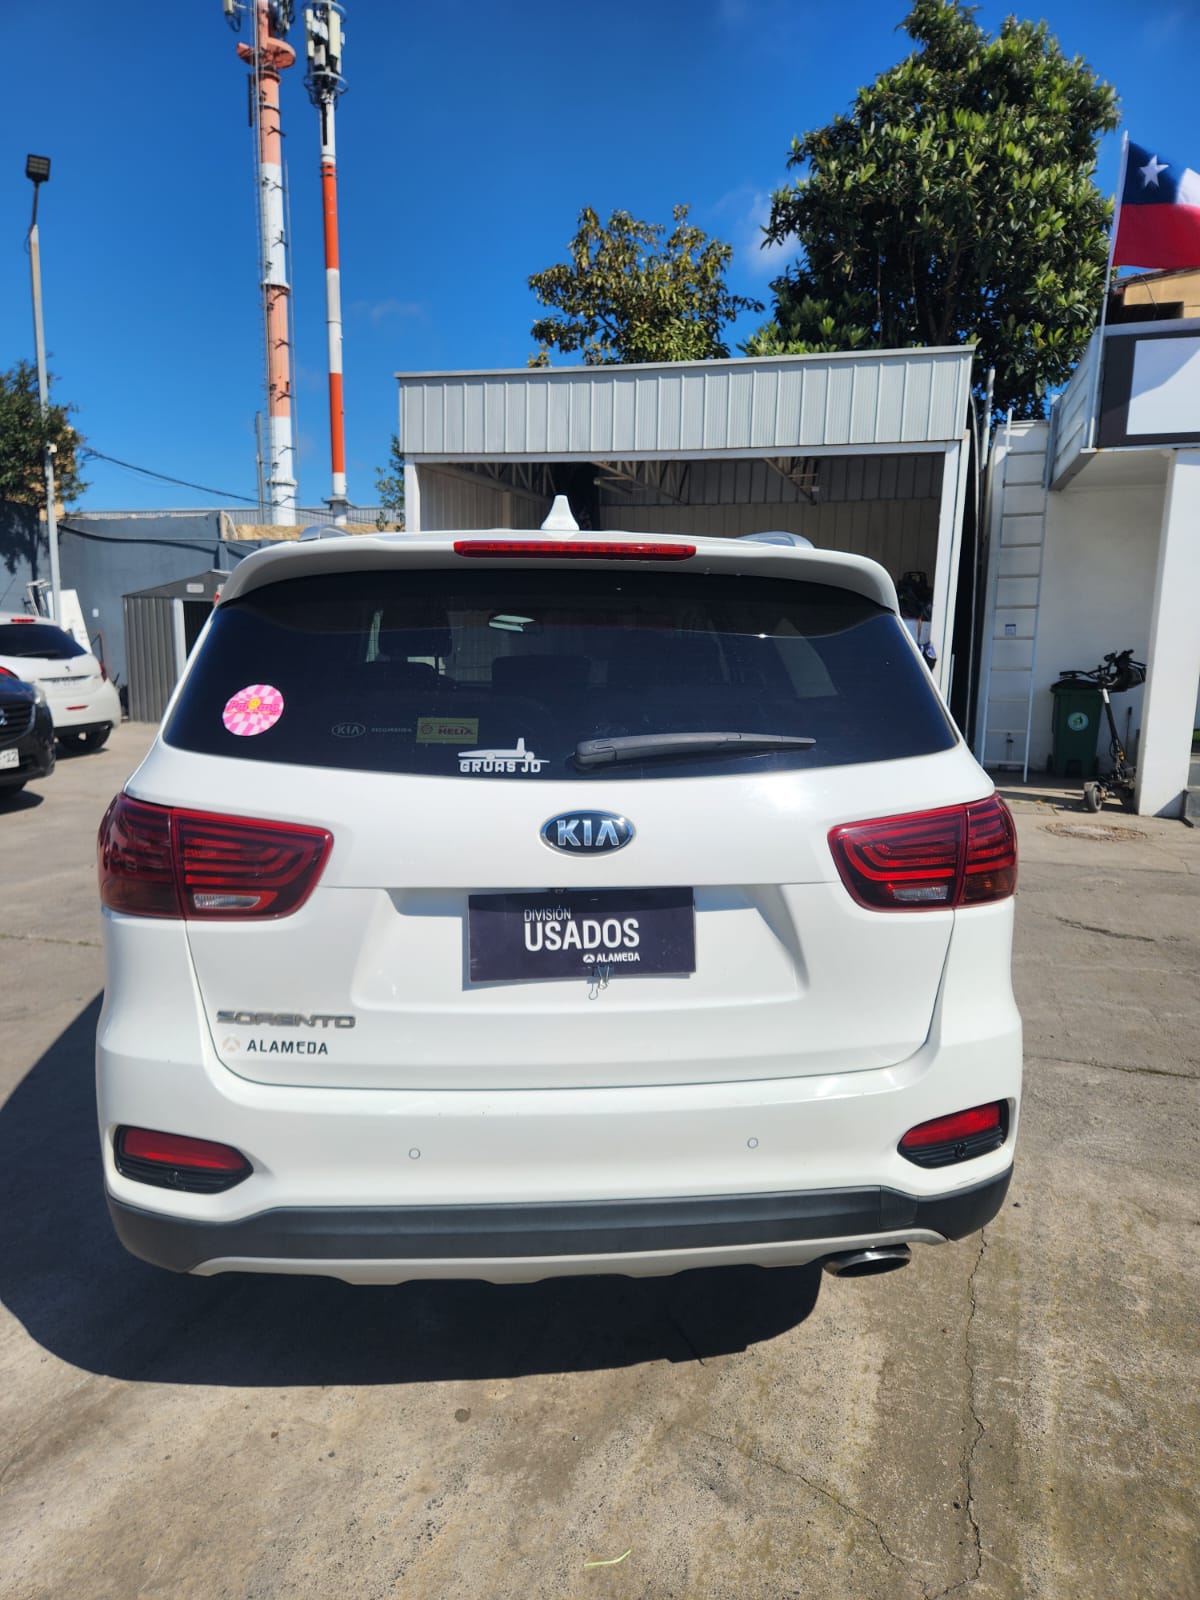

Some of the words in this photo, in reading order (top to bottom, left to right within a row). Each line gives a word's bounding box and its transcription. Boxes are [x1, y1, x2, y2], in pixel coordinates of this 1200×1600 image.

[337, 724, 360, 735] KIA
[438, 727, 473, 736] HELIX
[460, 761, 516, 773] GRUAS
[521, 761, 541, 774] JD
[556, 820, 620, 846] KIA
[524, 905, 571, 922] DIVISIÓN
[524, 918, 640, 951] USADOS
[596, 952, 641, 963] ALAMEDA
[216, 1010, 356, 1029] SORENTO
[246, 1039, 329, 1055] ALAMEDA
